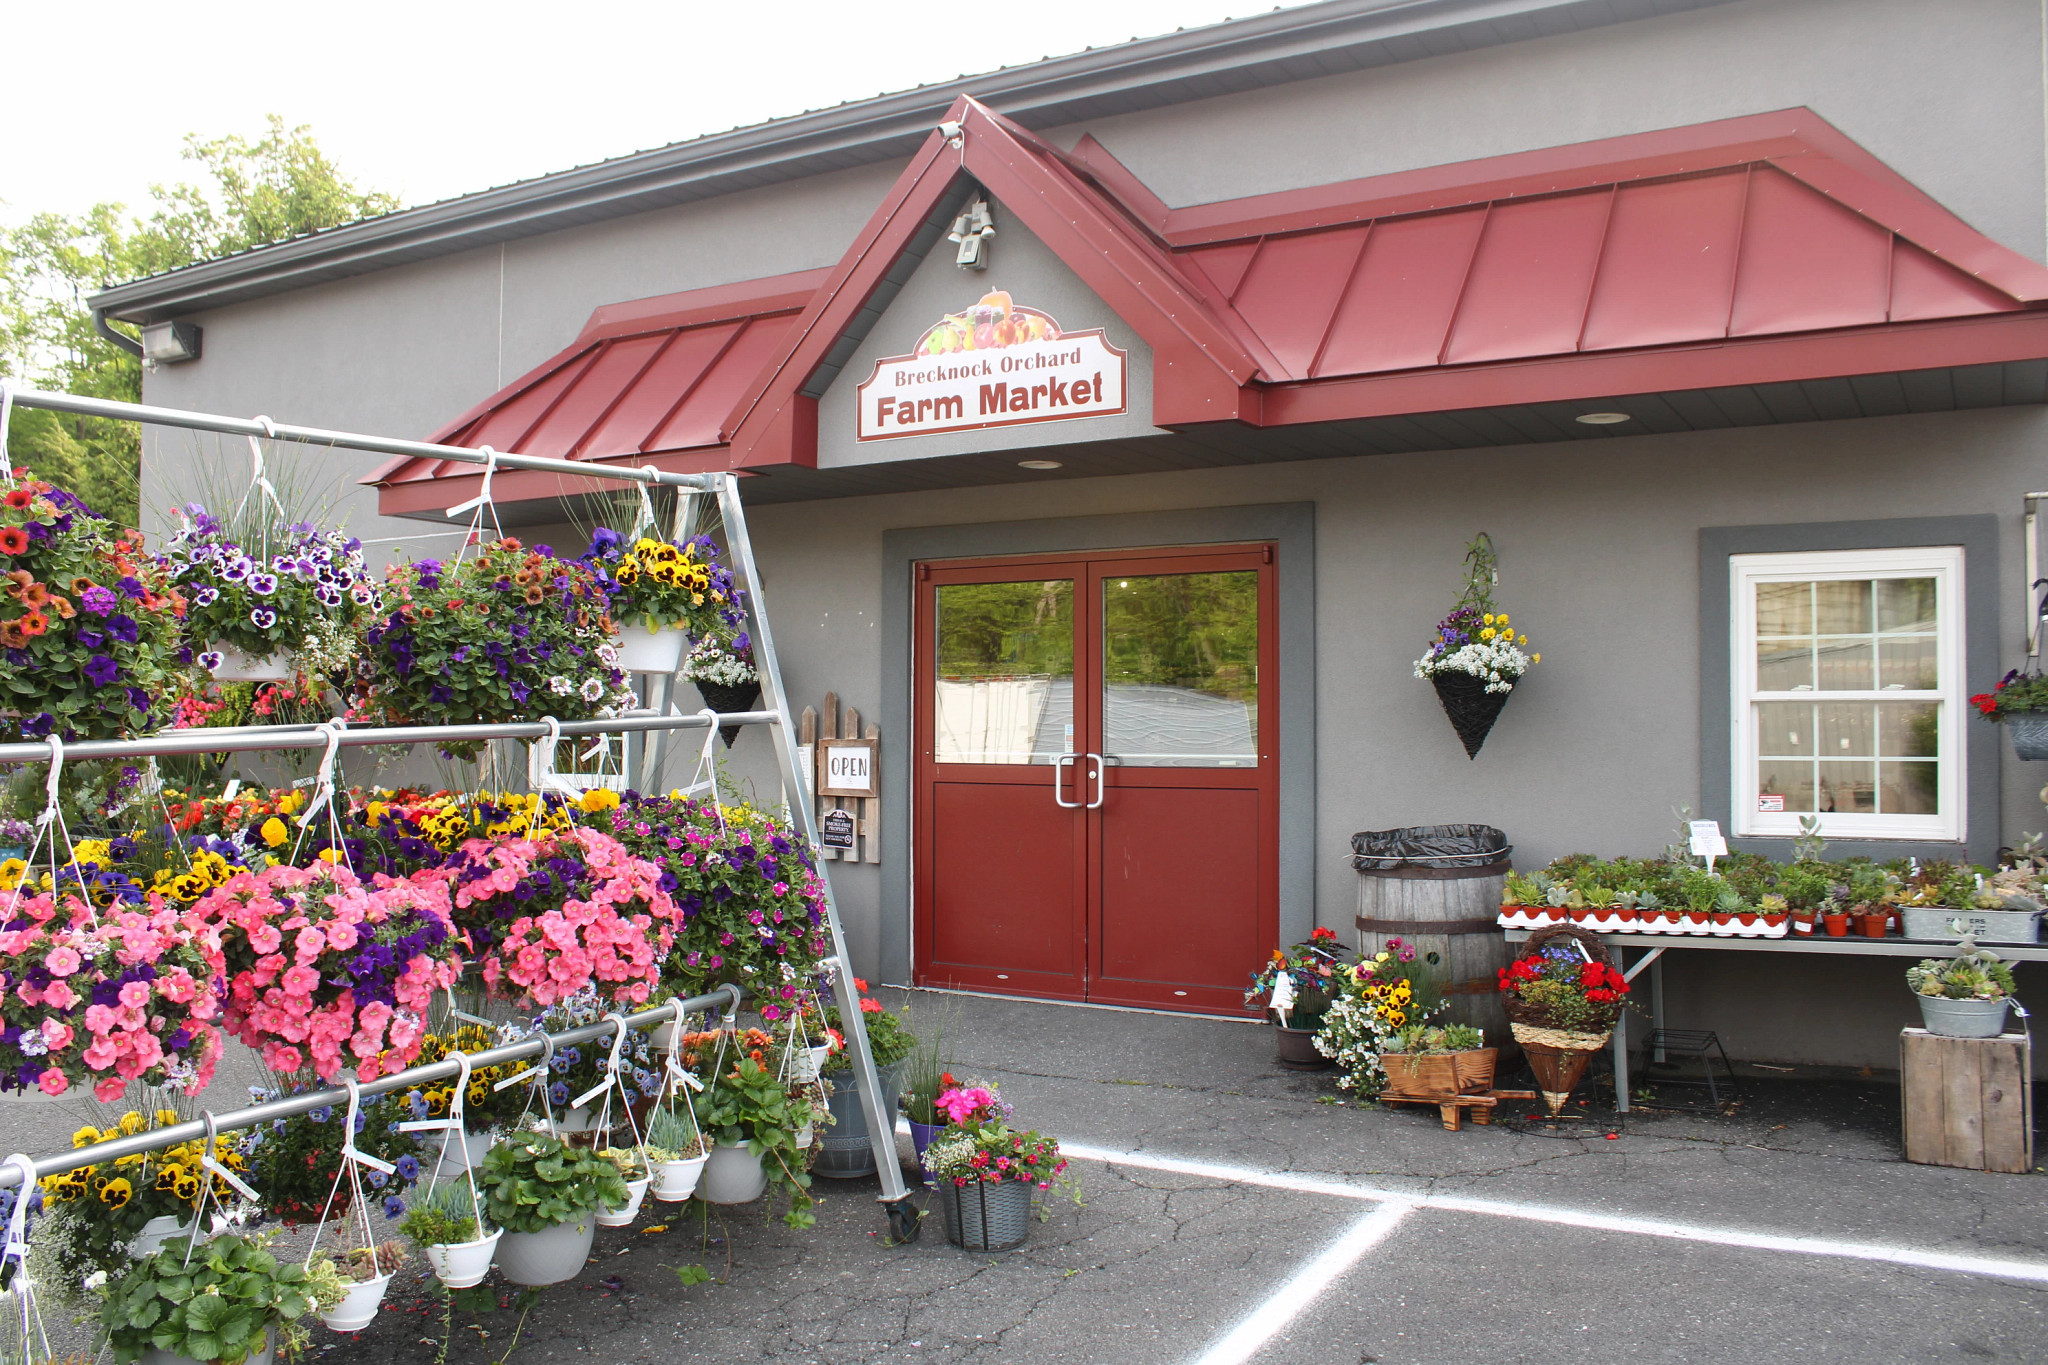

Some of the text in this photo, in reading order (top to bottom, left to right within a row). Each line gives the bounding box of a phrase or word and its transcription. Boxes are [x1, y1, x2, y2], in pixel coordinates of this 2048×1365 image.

[895, 347, 1081, 387] Brecknock Orchard
[877, 371, 1103, 427] Farm Market
[831, 757, 867, 776] OPEN
